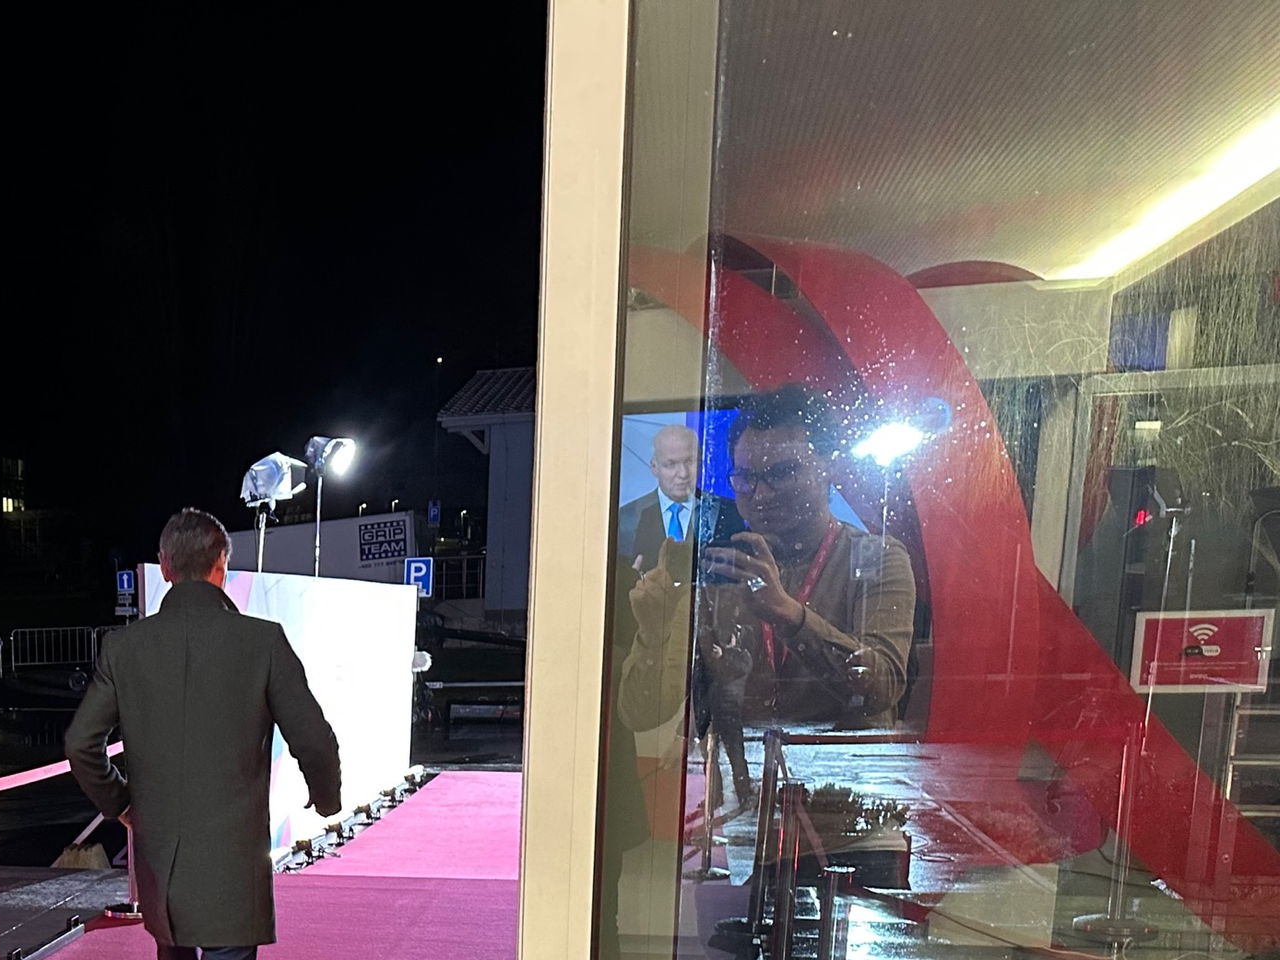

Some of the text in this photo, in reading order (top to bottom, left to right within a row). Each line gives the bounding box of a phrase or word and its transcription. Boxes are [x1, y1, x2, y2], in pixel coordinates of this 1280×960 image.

[362, 526, 404, 542] GRIP
[361, 541, 404, 555] TEAM
[410, 562, 427, 584] P
